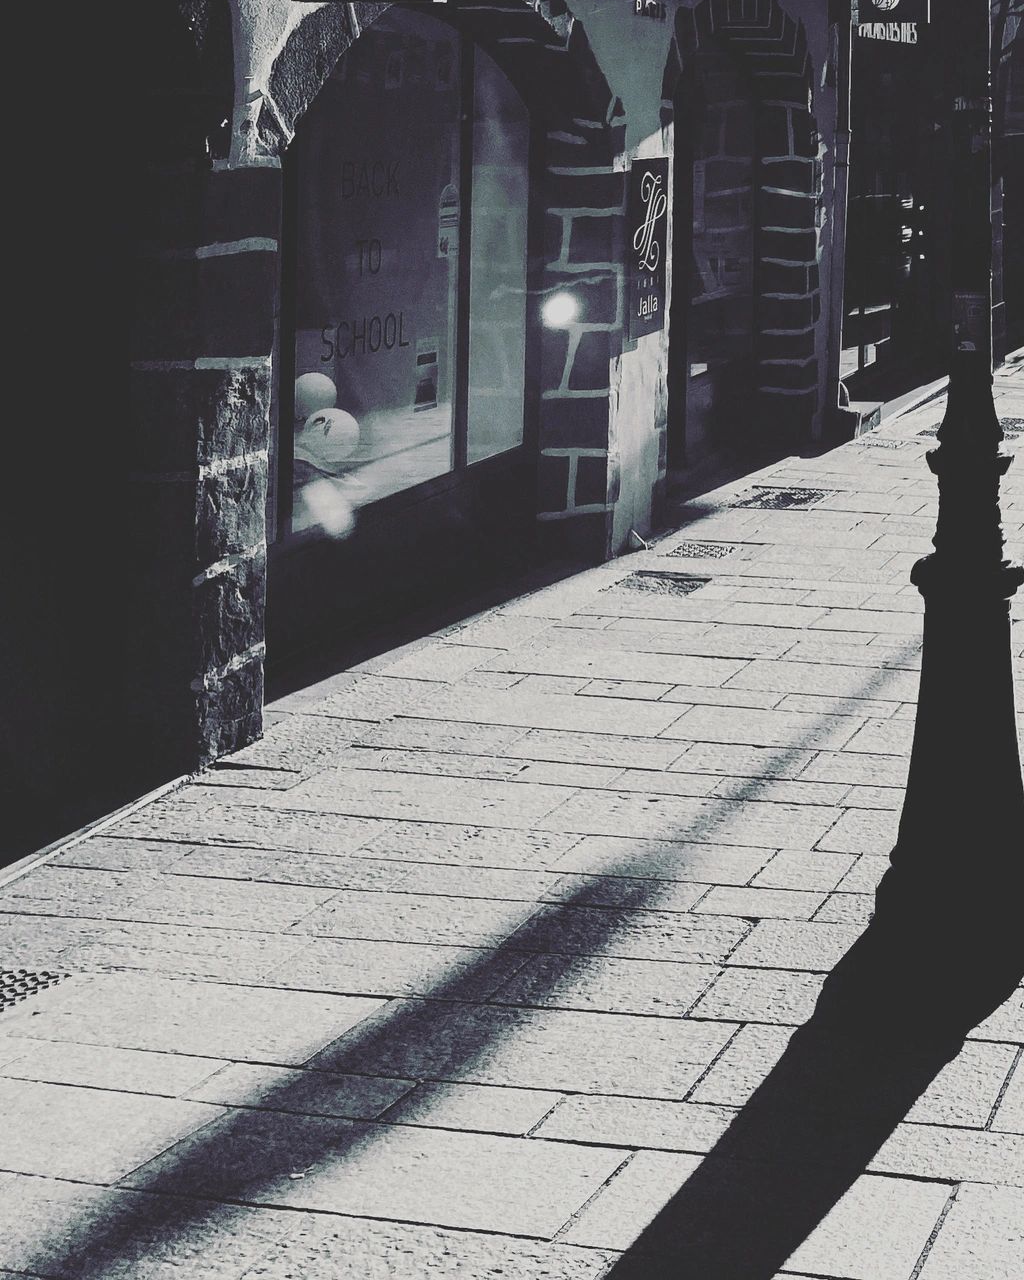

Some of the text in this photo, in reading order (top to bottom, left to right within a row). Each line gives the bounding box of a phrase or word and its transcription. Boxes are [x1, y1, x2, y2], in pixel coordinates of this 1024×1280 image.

[341, 162, 400, 200] BACK
[355, 239, 383, 276] TO
[637, 294, 658, 317] Jalla
[320, 312, 410, 363] SCHOOL
